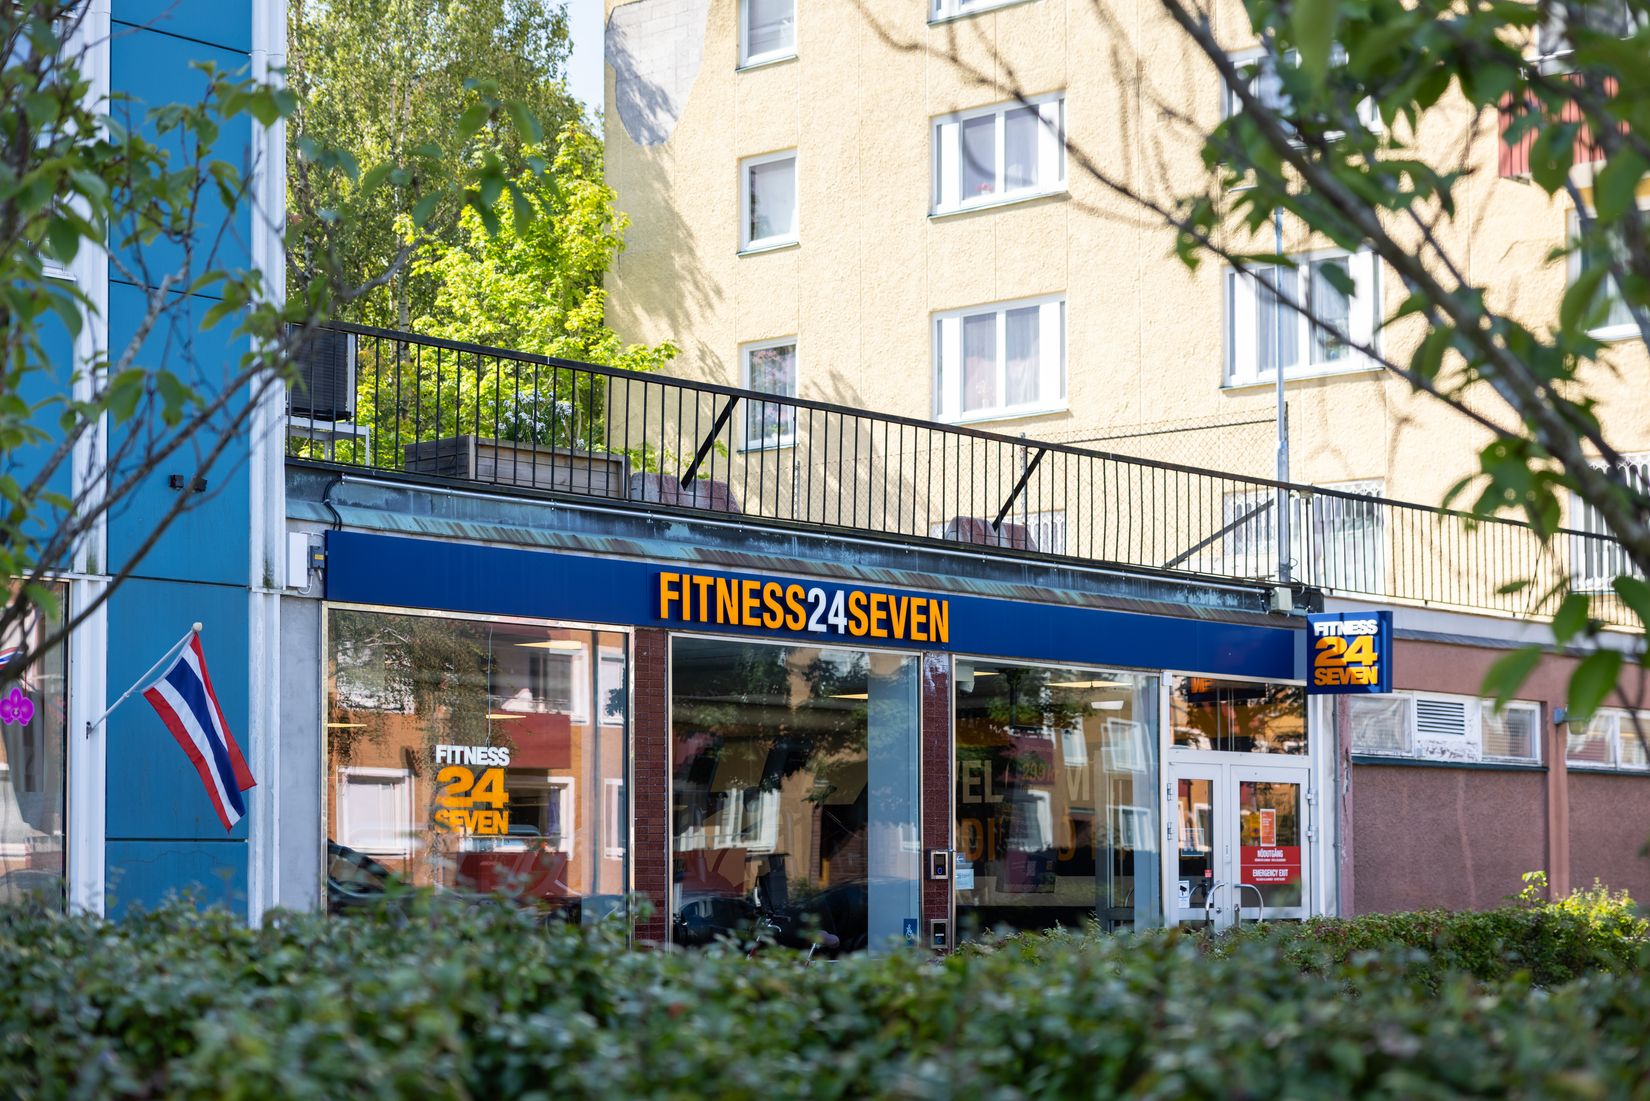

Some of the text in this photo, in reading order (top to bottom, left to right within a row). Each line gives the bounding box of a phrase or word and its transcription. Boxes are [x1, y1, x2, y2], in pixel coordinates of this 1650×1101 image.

[659, 571, 949, 643] FITNESS24SEVEN
[1313, 619, 1378, 636] FITNESS
[1314, 635, 1378, 667] 24
[1314, 666, 1378, 686] SEVEN
[435, 745, 510, 767] FITNESS
[435, 765, 510, 809] 24
[434, 809, 509, 834] SEVEN
[1252, 869, 1289, 877] EMERGENCY EXIT
